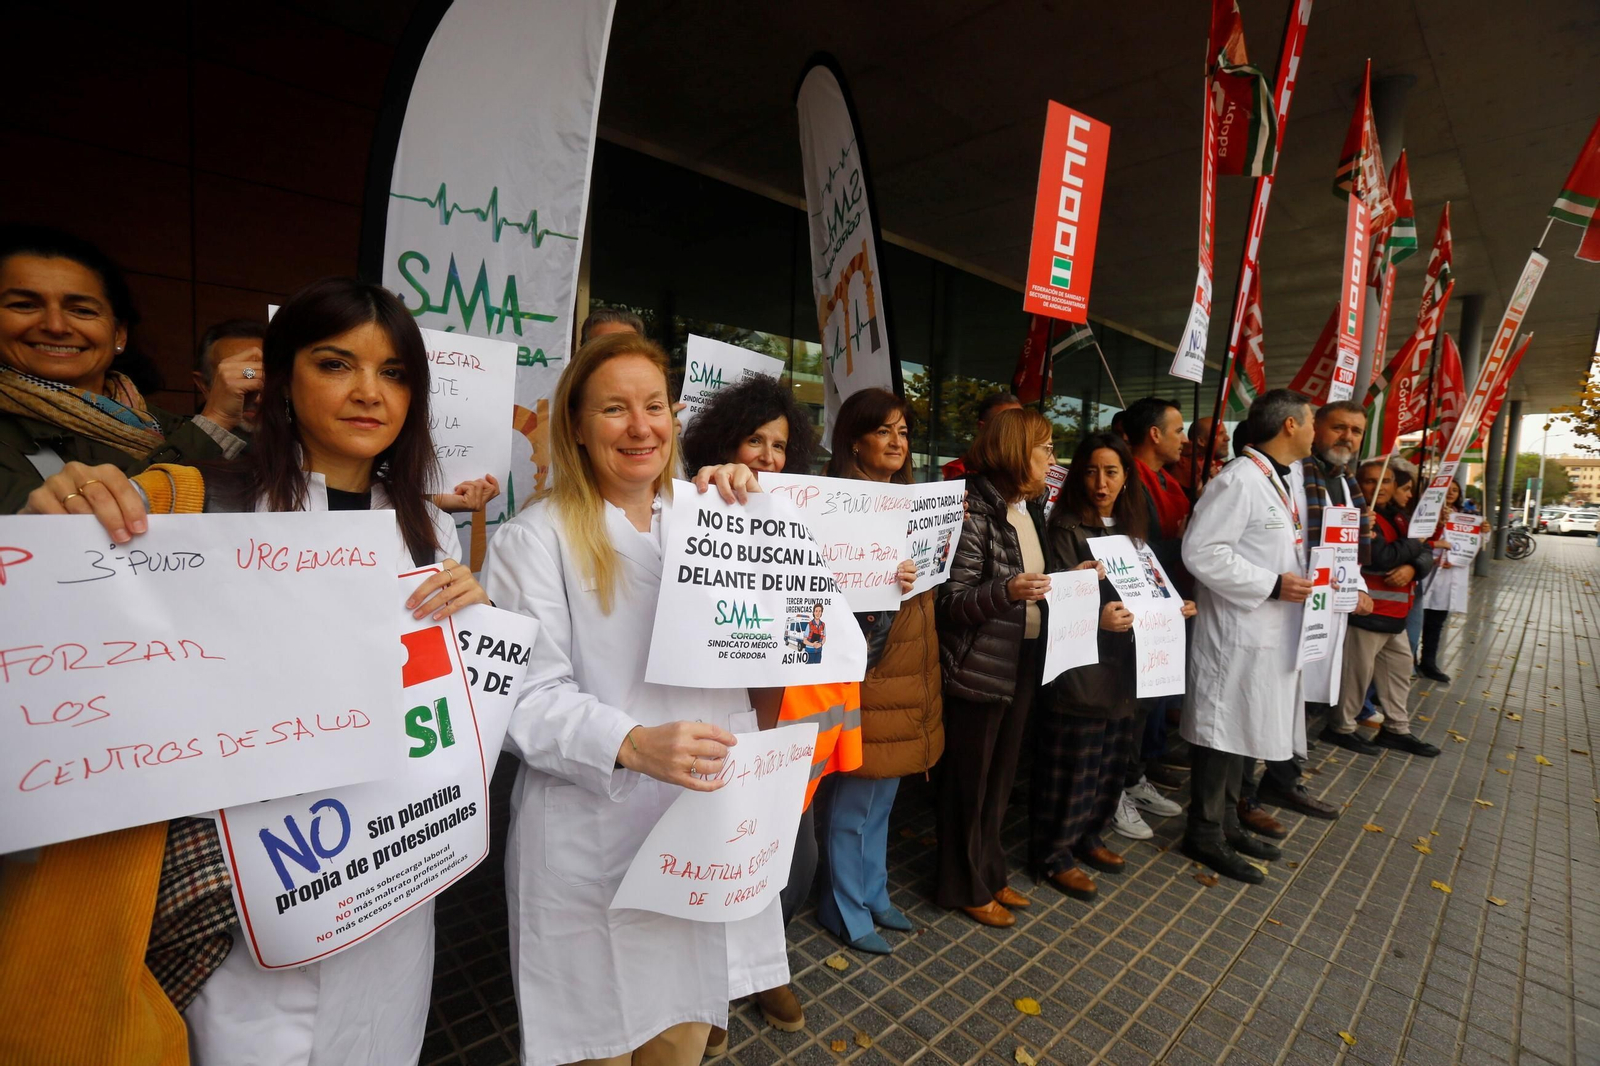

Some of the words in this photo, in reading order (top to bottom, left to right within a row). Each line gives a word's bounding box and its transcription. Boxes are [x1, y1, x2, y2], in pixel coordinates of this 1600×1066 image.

[1053, 114, 1091, 256] CCOO
[1349, 203, 1365, 310] CCOO
[398, 250, 558, 336] SMA
[1029, 291, 1051, 301] SECTORES
[1032, 284, 1058, 296] FEDERACIÓN
[1064, 292, 1081, 302] SANIDAD
[1049, 303, 1072, 313] ANDALUCÍA
[689, 361, 731, 390] SMA
[1339, 369, 1354, 383] STOP
[1450, 327, 1513, 455] CCOO
[445, 416, 462, 430] LA
[937, 495, 956, 508] TARDA
[697, 508, 723, 530] NO
[726, 515, 745, 535] ES
[750, 518, 786, 537] POR
[920, 515, 933, 530] CON
[934, 515, 941, 526] TU
[1453, 523, 1475, 533] STOP
[128, 549, 206, 573] PUNTO
[685, 533, 733, 560] SÓLO
[737, 544, 804, 566] BUSCAN
[869, 542, 898, 561] PROPIA
[678, 564, 756, 590] DELANTE
[762, 573, 782, 591] DE
[785, 574, 806, 592] UN
[714, 599, 775, 630] SMA
[786, 597, 803, 606] TERCER
[804, 598, 823, 607] PUNTO
[823, 598, 832, 606] DE
[1312, 592, 1327, 611] SI
[475, 634, 532, 667] PARA
[707, 639, 750, 649] SINDICATO
[750, 639, 778, 649] MÉDICO
[718, 651, 729, 659] DE
[729, 650, 767, 660] CÓRDOBA
[781, 651, 797, 665] ASÍ
[797, 652, 808, 664] NO
[483, 671, 514, 696] DE
[20, 696, 111, 727] LOS
[404, 696, 456, 759] SI
[19, 738, 204, 792] CENTROS
[218, 730, 260, 757] DE
[265, 709, 372, 745] SALUD
[367, 813, 394, 840] Sin
[397, 784, 462, 828] plantilla
[259, 798, 351, 892] NO
[275, 870, 342, 915] propia
[345, 857, 369, 881] de
[372, 801, 478, 870] profesionales
[338, 896, 354, 909] NO
[355, 886, 375, 901] más
[376, 861, 424, 888] sobrecarga
[423, 843, 451, 864] laboral
[659, 853, 742, 881] PLANTILLA
[316, 931, 333, 943] NO
[335, 920, 356, 935] más
[357, 901, 393, 924] excesos
[393, 893, 405, 904] en
[405, 872, 439, 898] guardias
[439, 853, 469, 876] médicas
[335, 910, 351, 923] NO
[353, 900, 373, 914] más
[374, 877, 412, 903] maltrato
[413, 851, 456, 883] profesional
[688, 891, 709, 905] DE
